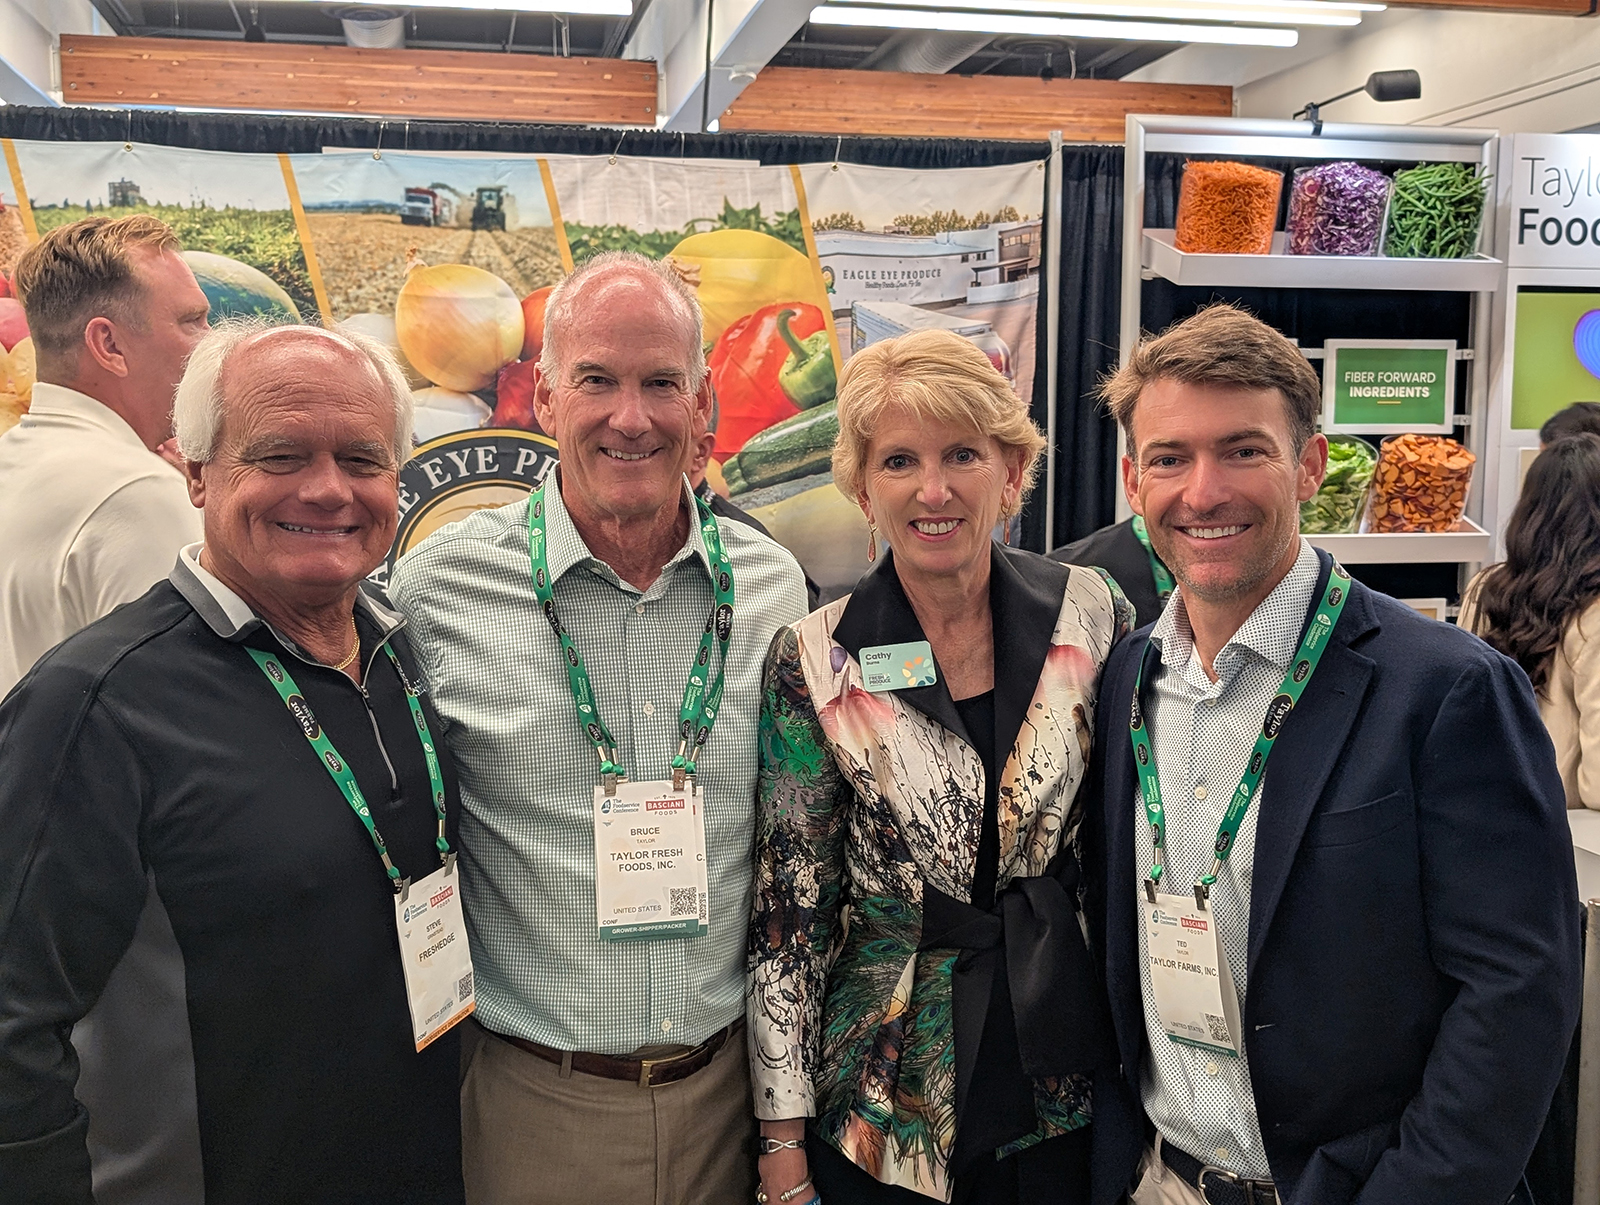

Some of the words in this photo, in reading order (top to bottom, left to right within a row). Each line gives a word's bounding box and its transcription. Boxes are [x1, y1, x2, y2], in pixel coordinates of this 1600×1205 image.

[843, 269, 877, 280] EAGLE
[881, 270, 898, 280] EYE
[901, 269, 942, 280] PRODUCE
[1344, 371, 1375, 383] FIBER
[1377, 371, 1436, 383] FORWARD
[1349, 386, 1430, 398] INGREDIENTS
[420, 445, 500, 490] EYE
[865, 652, 892, 660] Cathy
[290, 701, 314, 736] Taylor
[1269, 702, 1291, 736] Taylor
[647, 800, 684, 810] BASCIANI
[630, 827, 660, 835] BRUCE
[610, 849, 649, 861] TAYLOR
[652, 848, 683, 858] FRESH
[619, 862, 655, 872] FOODS,
[657, 860, 676, 870] INC.
[431, 889, 452, 905] BASCIANI
[613, 906, 637, 914] UNITED
[638, 905, 662, 913] STATES
[426, 918, 442, 933] STEVE
[1181, 918, 1207, 930] BASCIANI
[418, 932, 456, 963] FRESHEDGE
[1176, 940, 1188, 948] TED
[1150, 956, 1177, 969] TAYLOR
[1177, 961, 1204, 975] FARMS,
[1204, 966, 1219, 977] INC.
[425, 1010, 440, 1025] UNITED
[417, 1031, 427, 1041] CONF
